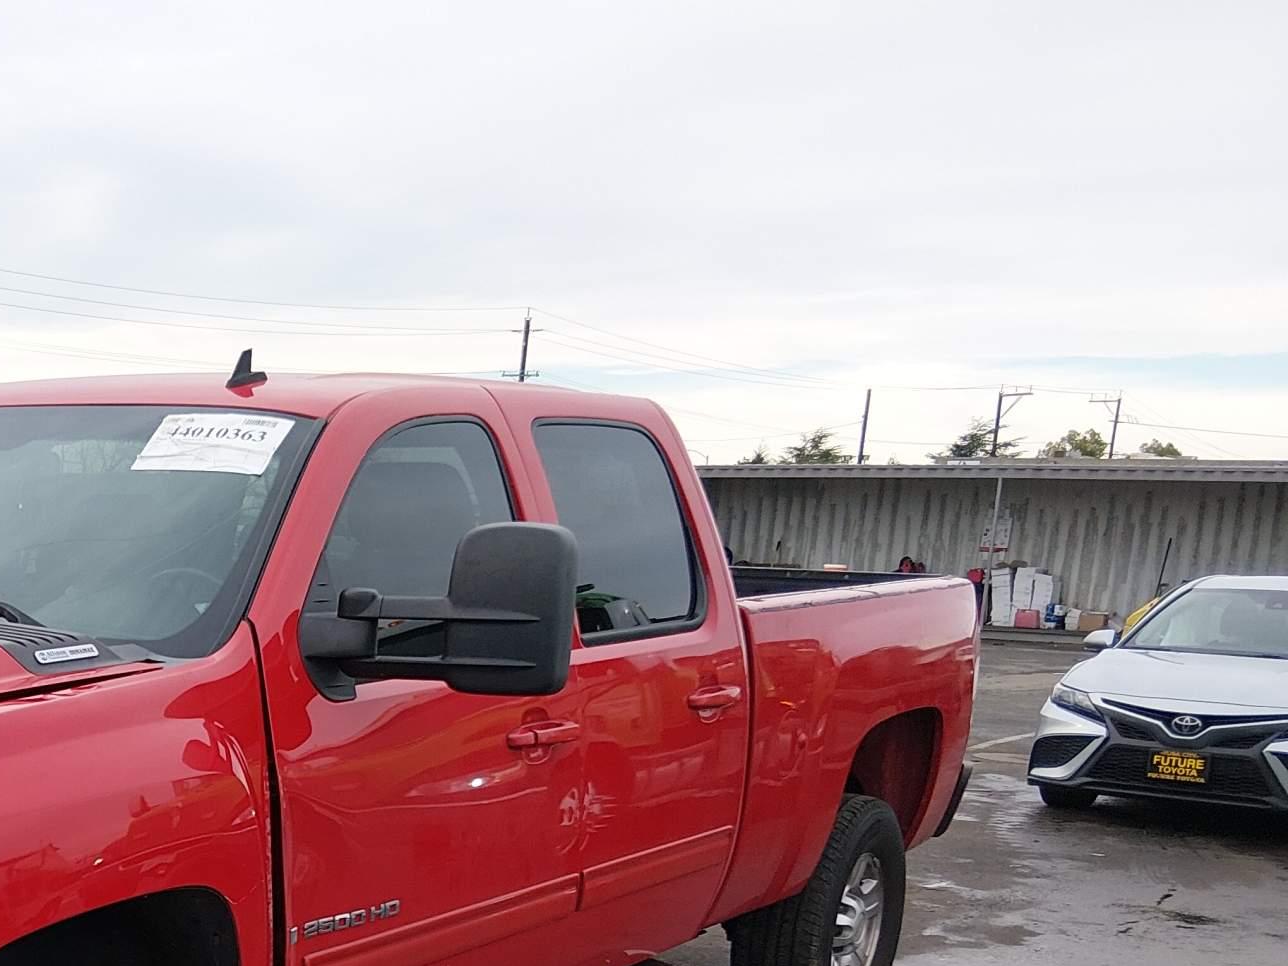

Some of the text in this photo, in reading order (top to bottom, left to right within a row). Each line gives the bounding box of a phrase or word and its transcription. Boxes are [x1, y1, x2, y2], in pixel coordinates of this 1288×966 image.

[168, 425, 267, 442] 44010363
[1153, 755, 1205, 769] FUTURE
[1158, 766, 1198, 776] TOYOTA
[304, 899, 400, 938] 2500 HD
